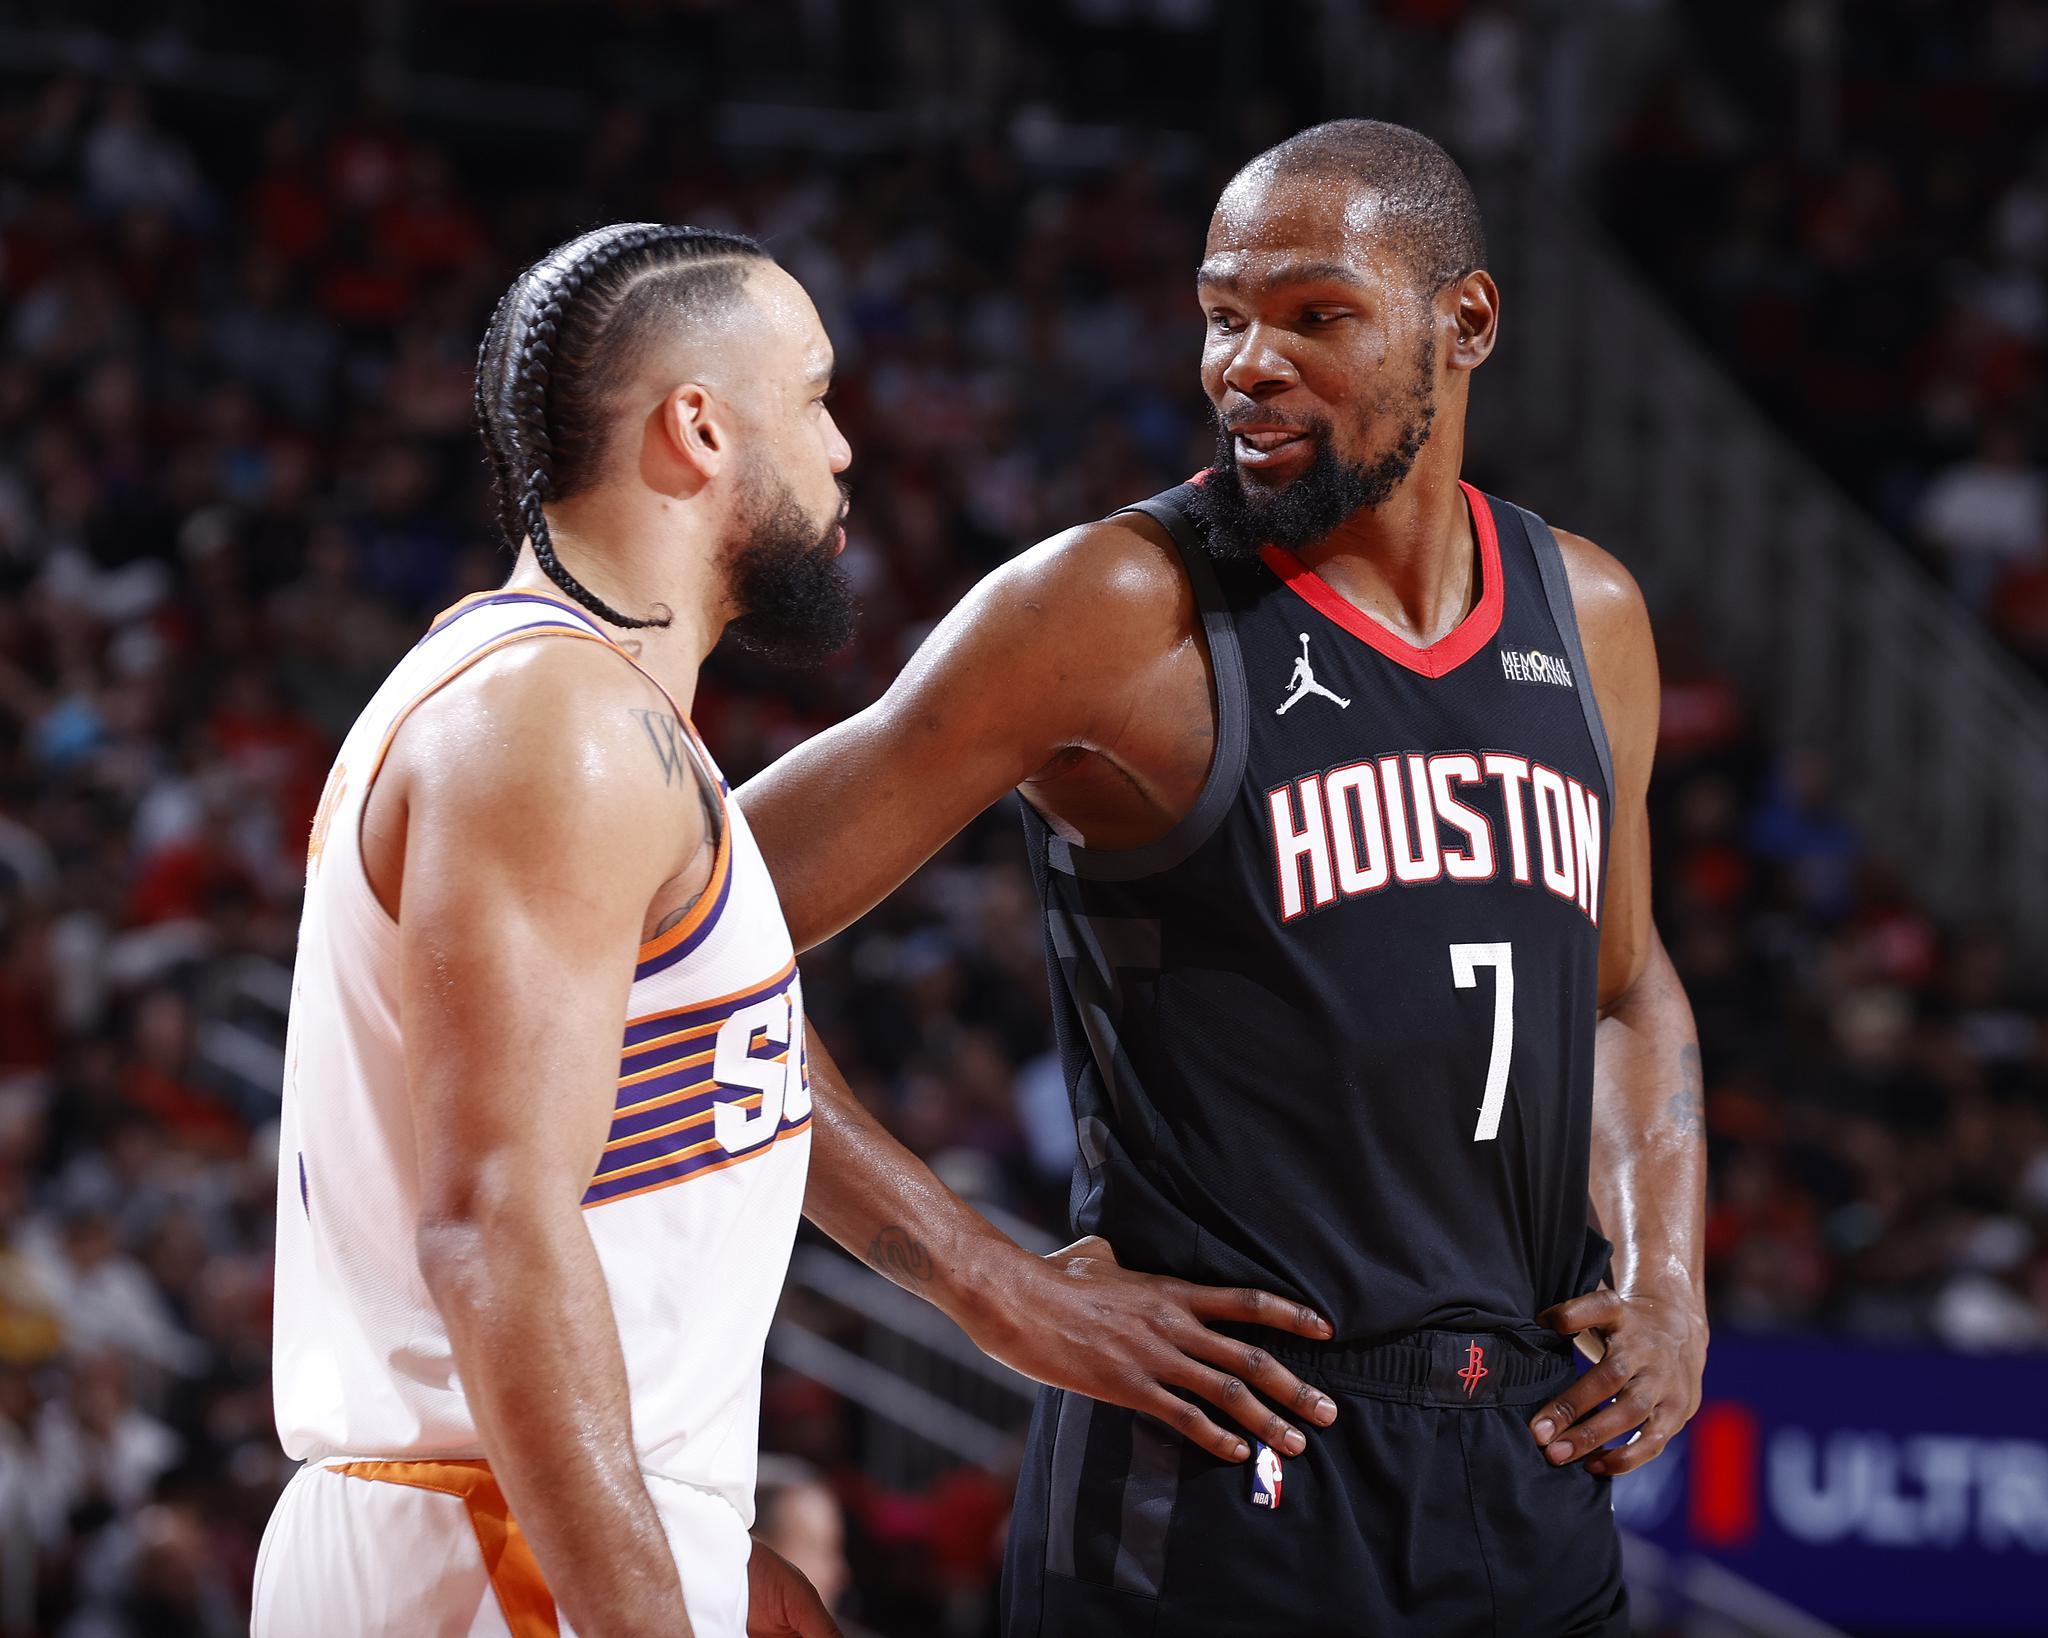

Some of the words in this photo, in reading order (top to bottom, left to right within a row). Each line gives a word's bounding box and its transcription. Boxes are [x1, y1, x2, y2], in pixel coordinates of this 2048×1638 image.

[1501, 650, 1570, 673] MEMORIAL
[1503, 665, 1573, 687] HERMANN
[1267, 752, 1600, 928] HOUSTON
[1449, 942, 1513, 1142] 7
[1253, 1491, 1270, 1505] NBA
